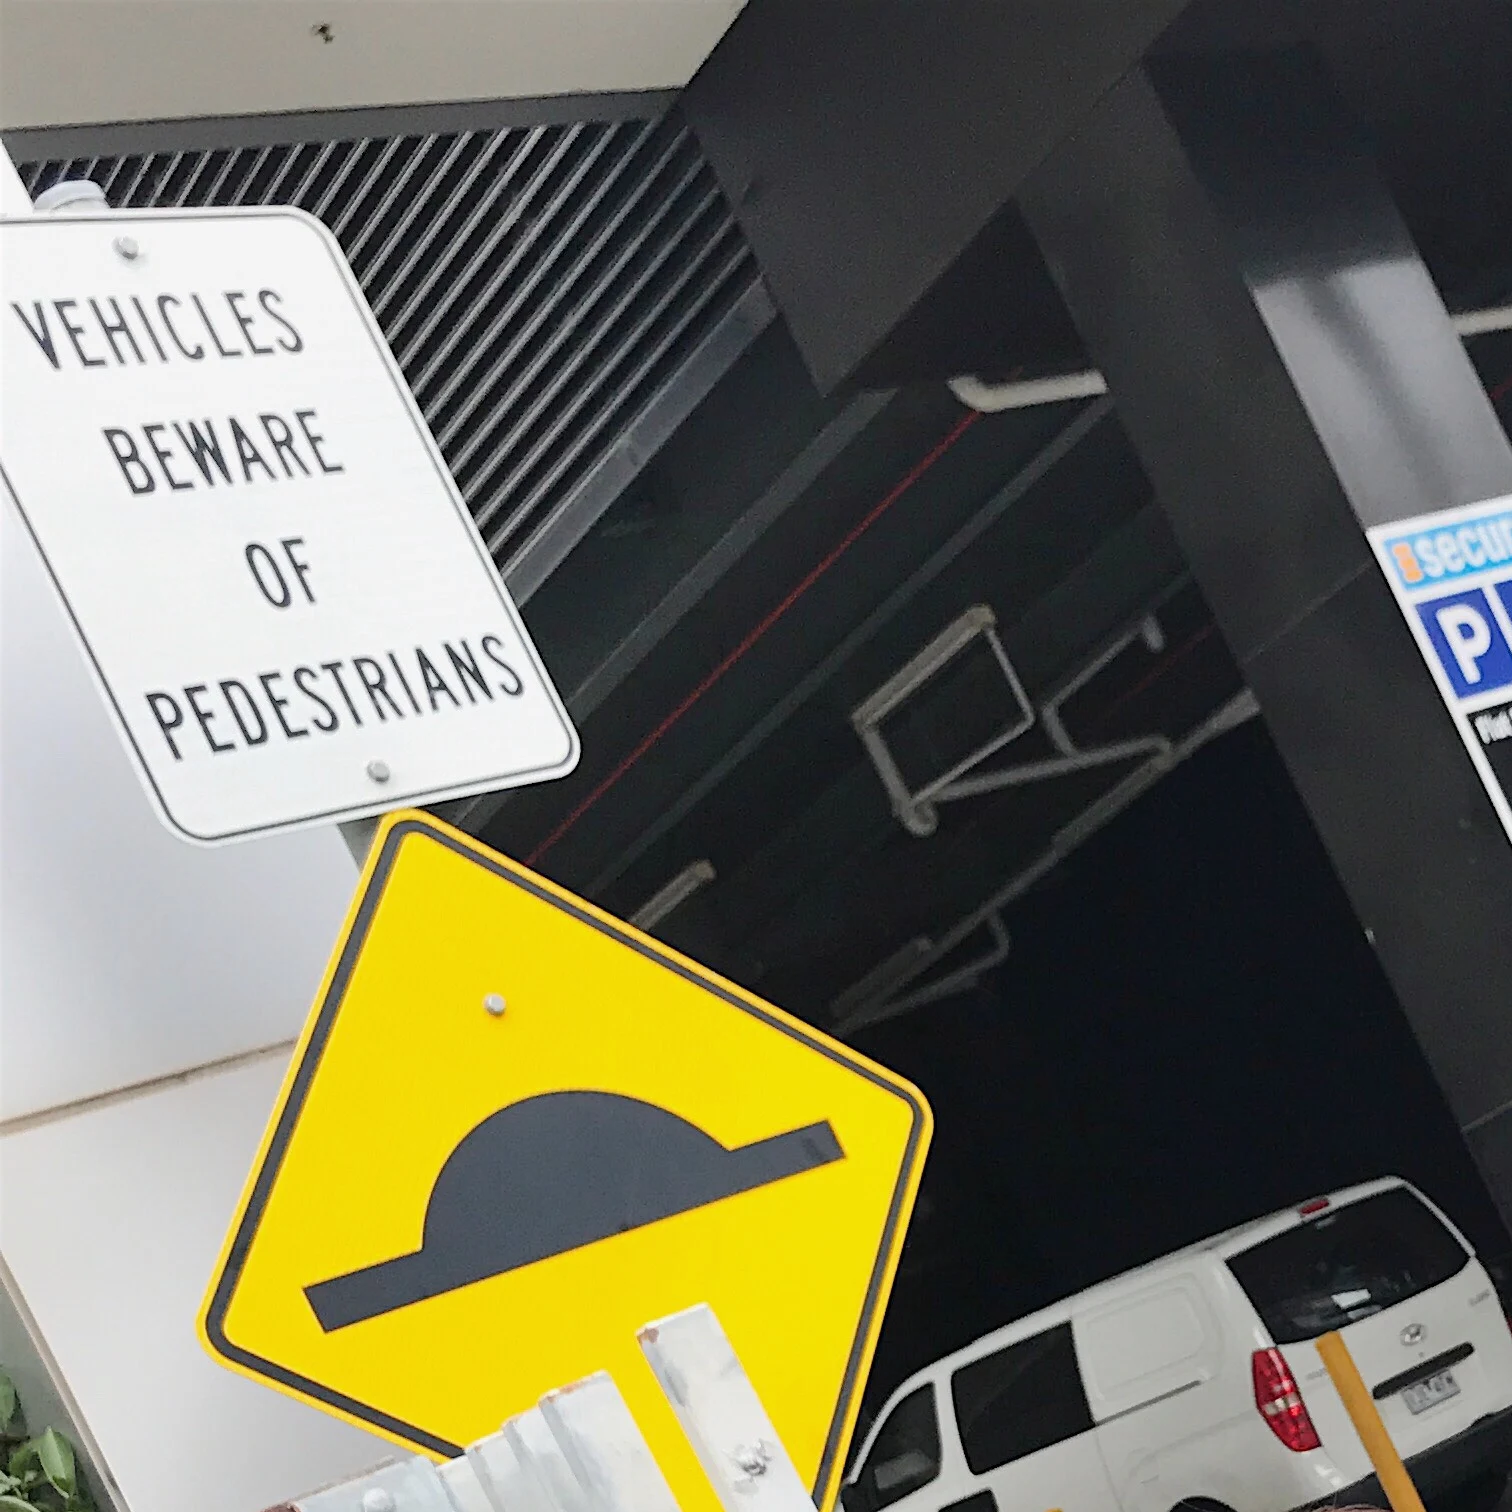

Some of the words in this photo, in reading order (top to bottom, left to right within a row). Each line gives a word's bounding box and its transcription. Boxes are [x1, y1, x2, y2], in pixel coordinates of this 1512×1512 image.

[12, 288, 305, 371] VEHICLES
[103, 410, 345, 496] BEWARE
[244, 538, 317, 609] OF
[1435, 603, 1492, 685] P
[146, 635, 525, 762] PEDESTRIANS
